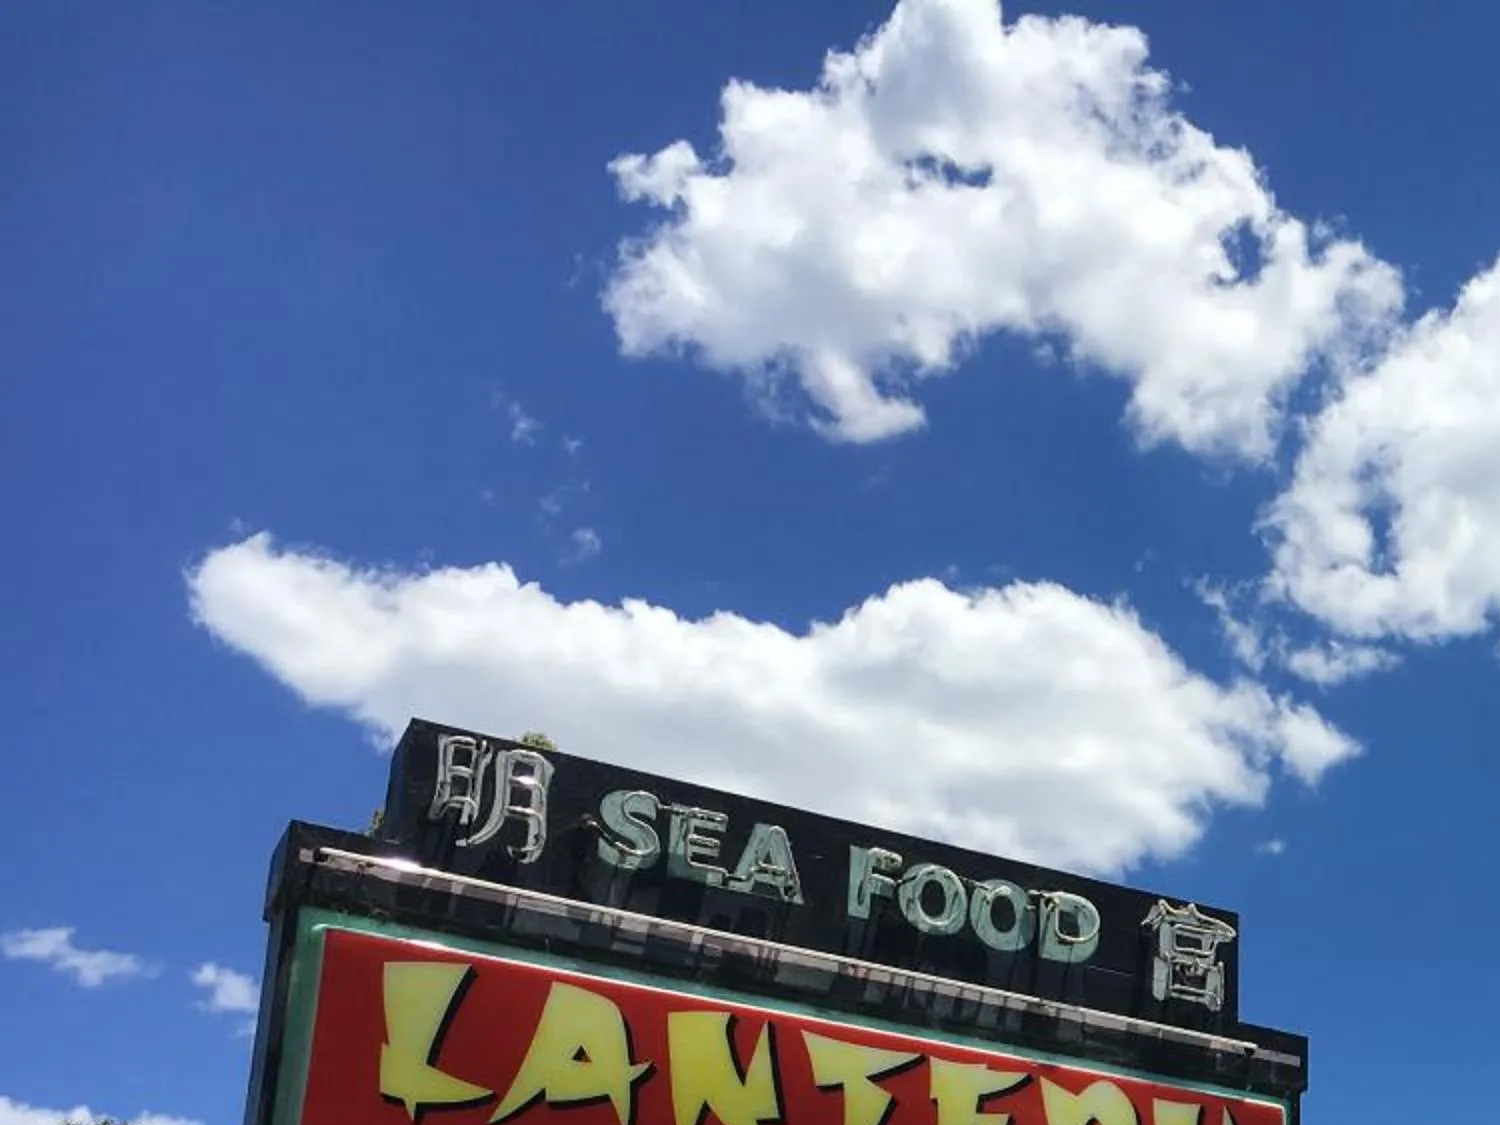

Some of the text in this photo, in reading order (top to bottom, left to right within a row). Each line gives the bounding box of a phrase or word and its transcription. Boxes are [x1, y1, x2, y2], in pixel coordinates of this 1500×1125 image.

[428, 734, 555, 864] 明
[598, 789, 1100, 963] SEA FOOD
